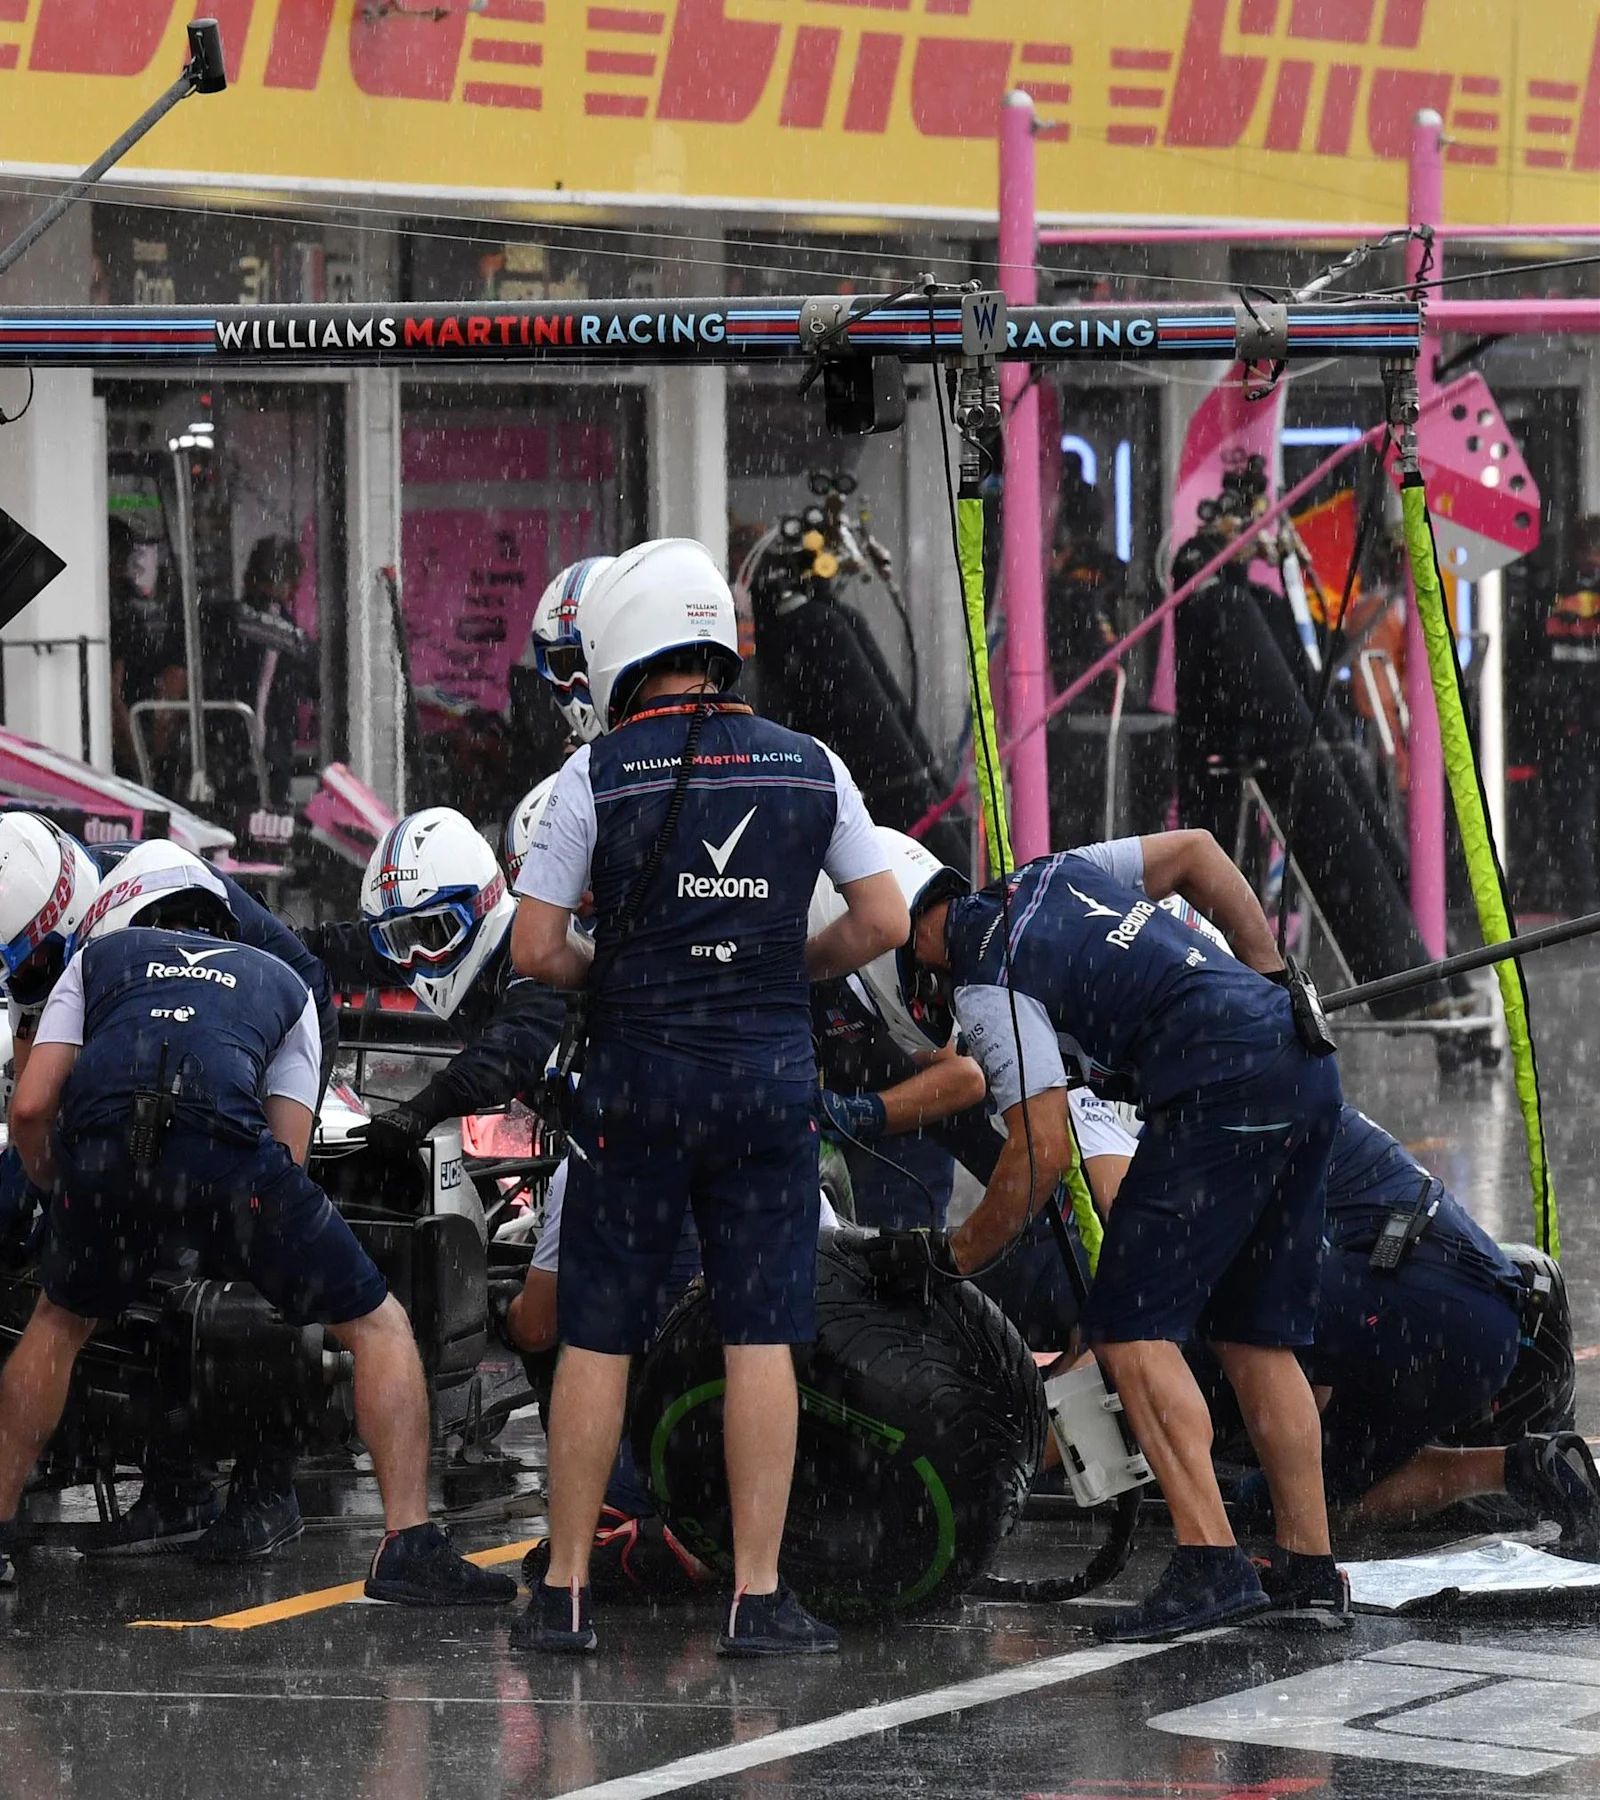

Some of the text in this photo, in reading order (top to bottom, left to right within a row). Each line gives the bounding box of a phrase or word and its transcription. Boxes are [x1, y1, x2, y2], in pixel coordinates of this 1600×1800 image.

[216, 312, 726, 350] WILLIAMS MARTINI RACING
[547, 605, 578, 619] MART
[623, 751, 802, 773] WILLIAM MARTINI RACING
[372, 869, 418, 890] MARTINI
[677, 872, 769, 899] Rexona
[979, 910, 1004, 961] WILLIAM
[1105, 900, 1156, 950] Rexona
[691, 945, 714, 957] BT
[146, 962, 237, 989] Rexona
[150, 1008, 173, 1018] BT
[826, 1020, 865, 1037] MARTINI
